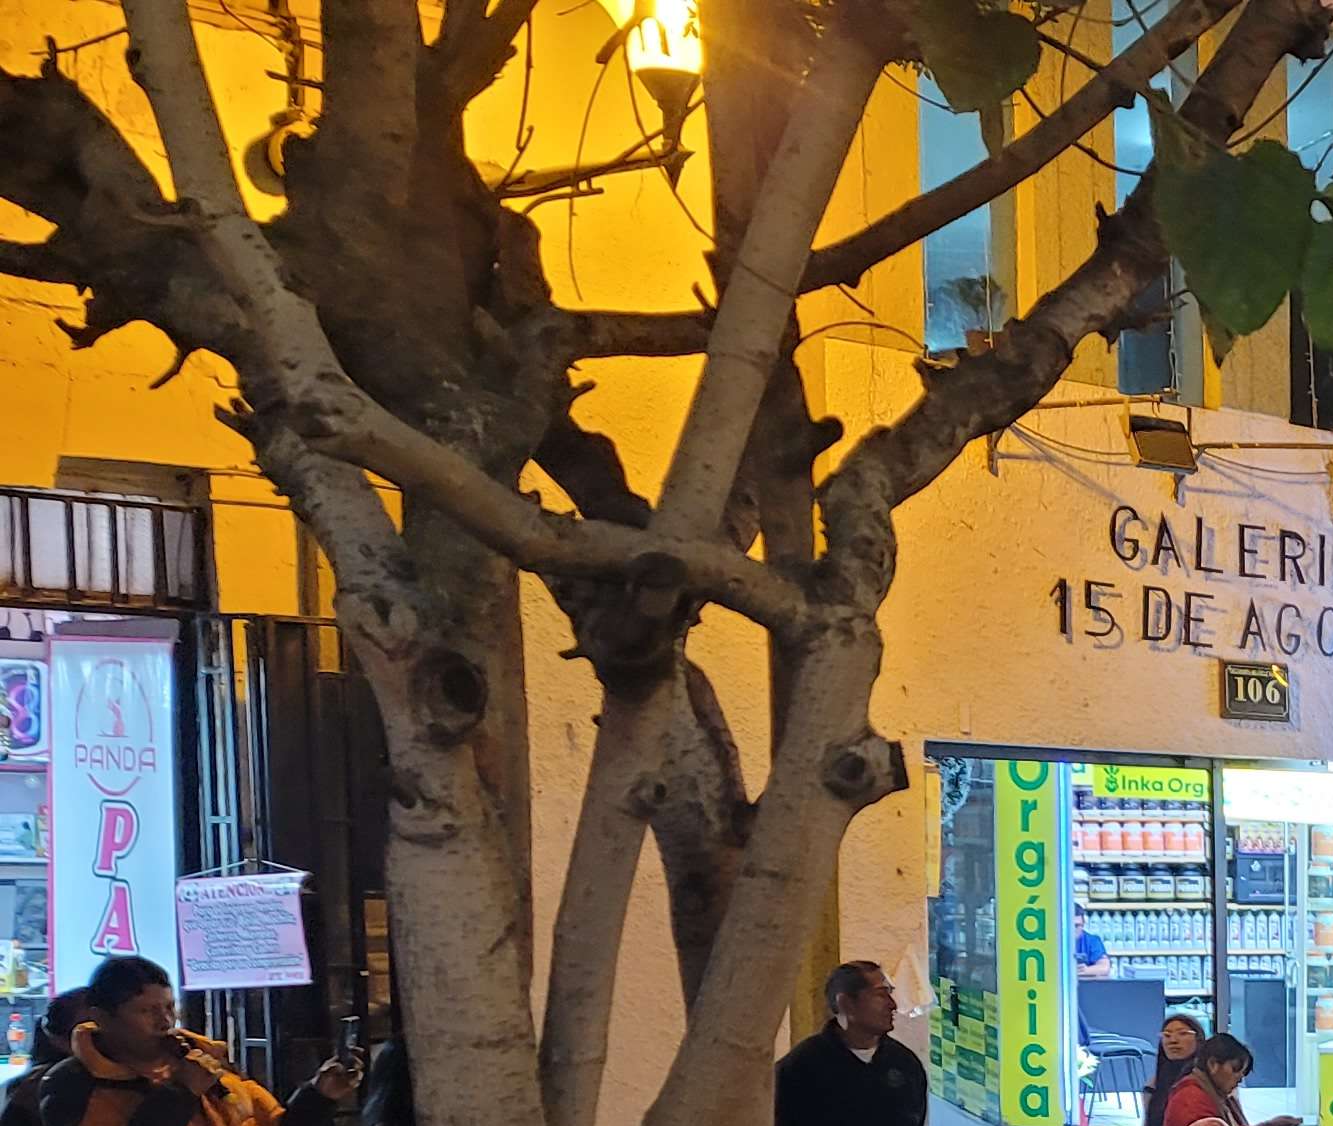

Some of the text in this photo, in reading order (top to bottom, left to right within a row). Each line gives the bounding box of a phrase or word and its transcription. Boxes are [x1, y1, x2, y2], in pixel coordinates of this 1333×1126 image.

[1049, 577, 1116, 637] 15
[1142, 584, 1214, 649] DE
[1233, 676, 1281, 704] 106
[74, 743, 157, 774] PANDA
[1121, 774, 1164, 792] Inka
